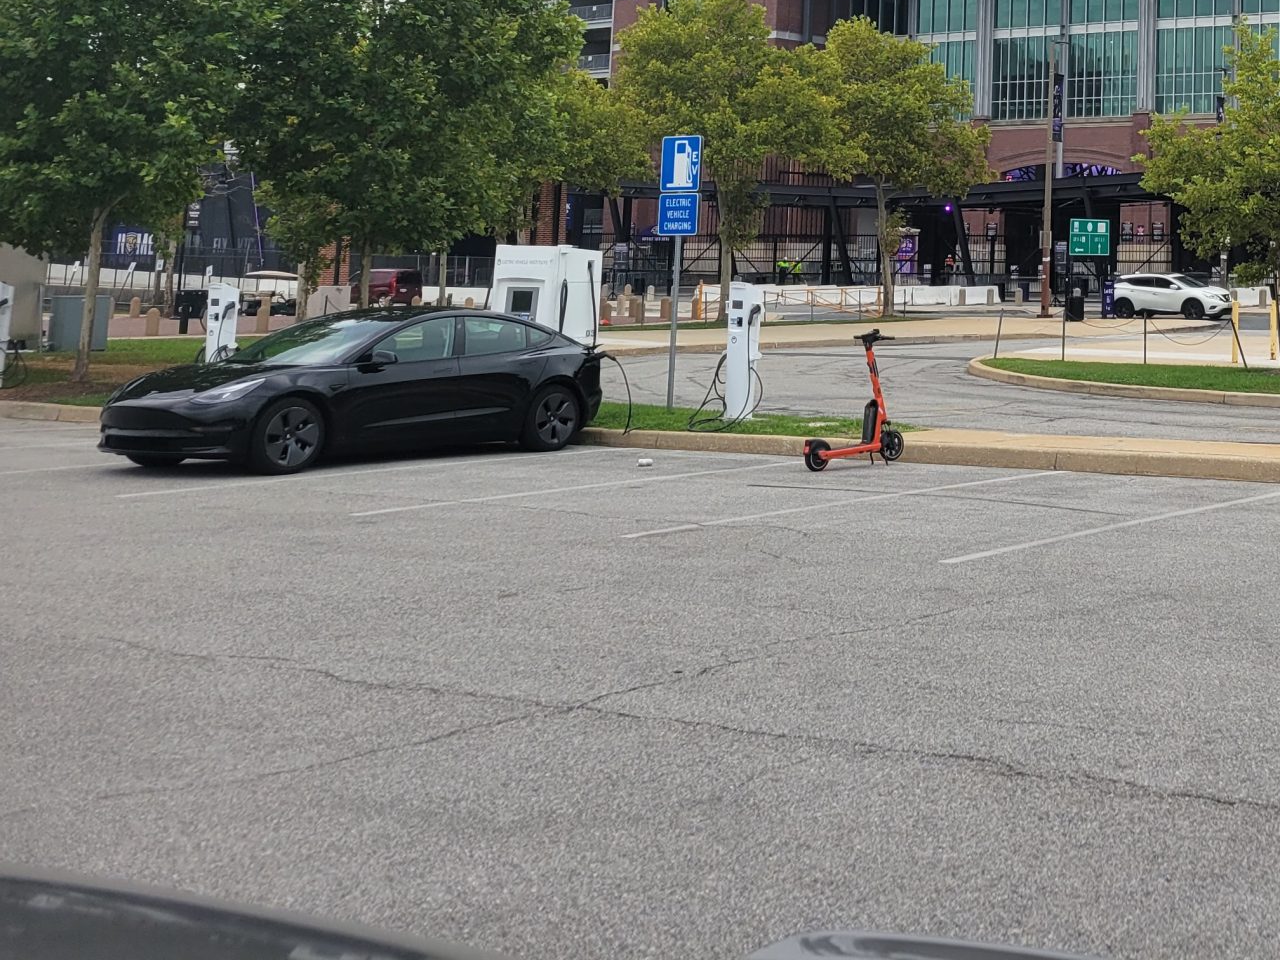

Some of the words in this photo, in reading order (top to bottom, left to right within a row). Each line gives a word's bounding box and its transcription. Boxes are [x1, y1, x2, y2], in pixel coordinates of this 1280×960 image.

[665, 198, 692, 208] ELECTRIC
[666, 209, 690, 219] VEHICLE
[663, 221, 692, 231] CHARGING
